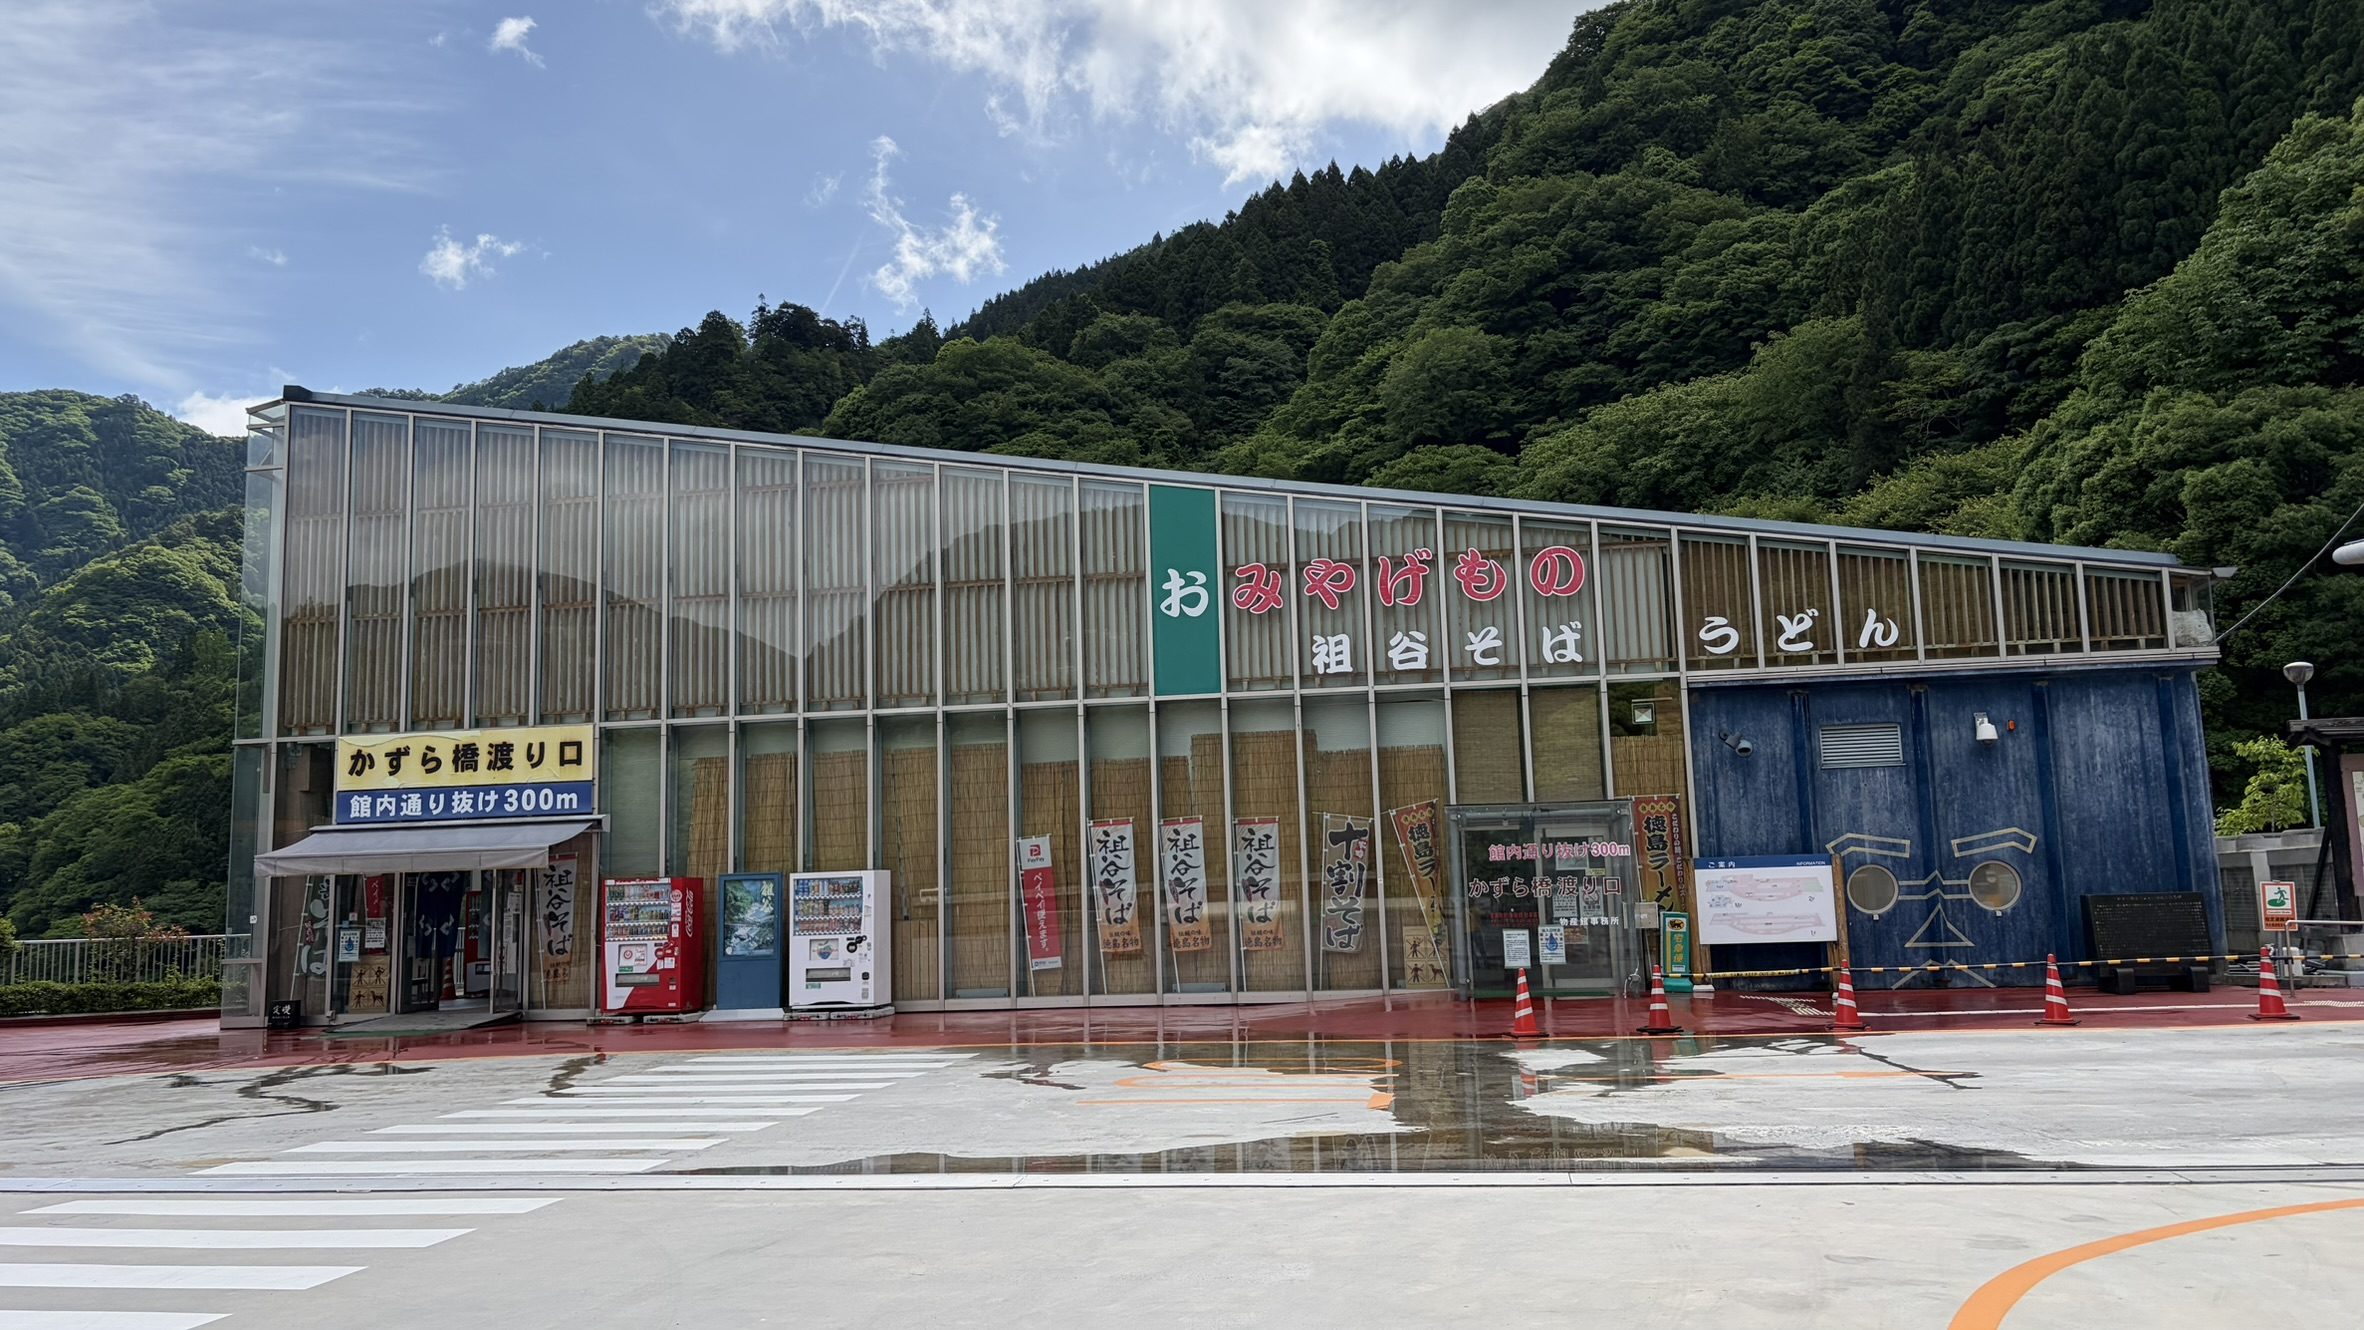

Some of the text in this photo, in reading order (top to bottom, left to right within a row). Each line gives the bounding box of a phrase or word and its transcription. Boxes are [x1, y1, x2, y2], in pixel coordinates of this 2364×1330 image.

[1160, 545, 1585, 618] おみやげもの
[1311, 607, 1899, 675] 祖谷そば うどん
[347, 739, 583, 777] かずら橋渡り口
[349, 787, 578, 819] 館内通り抜け300m
[1096, 829, 1133, 926] 祖谷そば
[1166, 827, 1203, 924] 祖谷そば
[1241, 827, 1277, 923] 祖谷そば
[1326, 820, 1370, 951] 十割そば
[1468, 875, 1622, 898] かずら橋渡り口
[1488, 842, 1631, 861] 館内通り抜け300m
[543, 864, 574, 956] 祖谷そば
[1559, 916, 1620, 926] 物産館事務所
